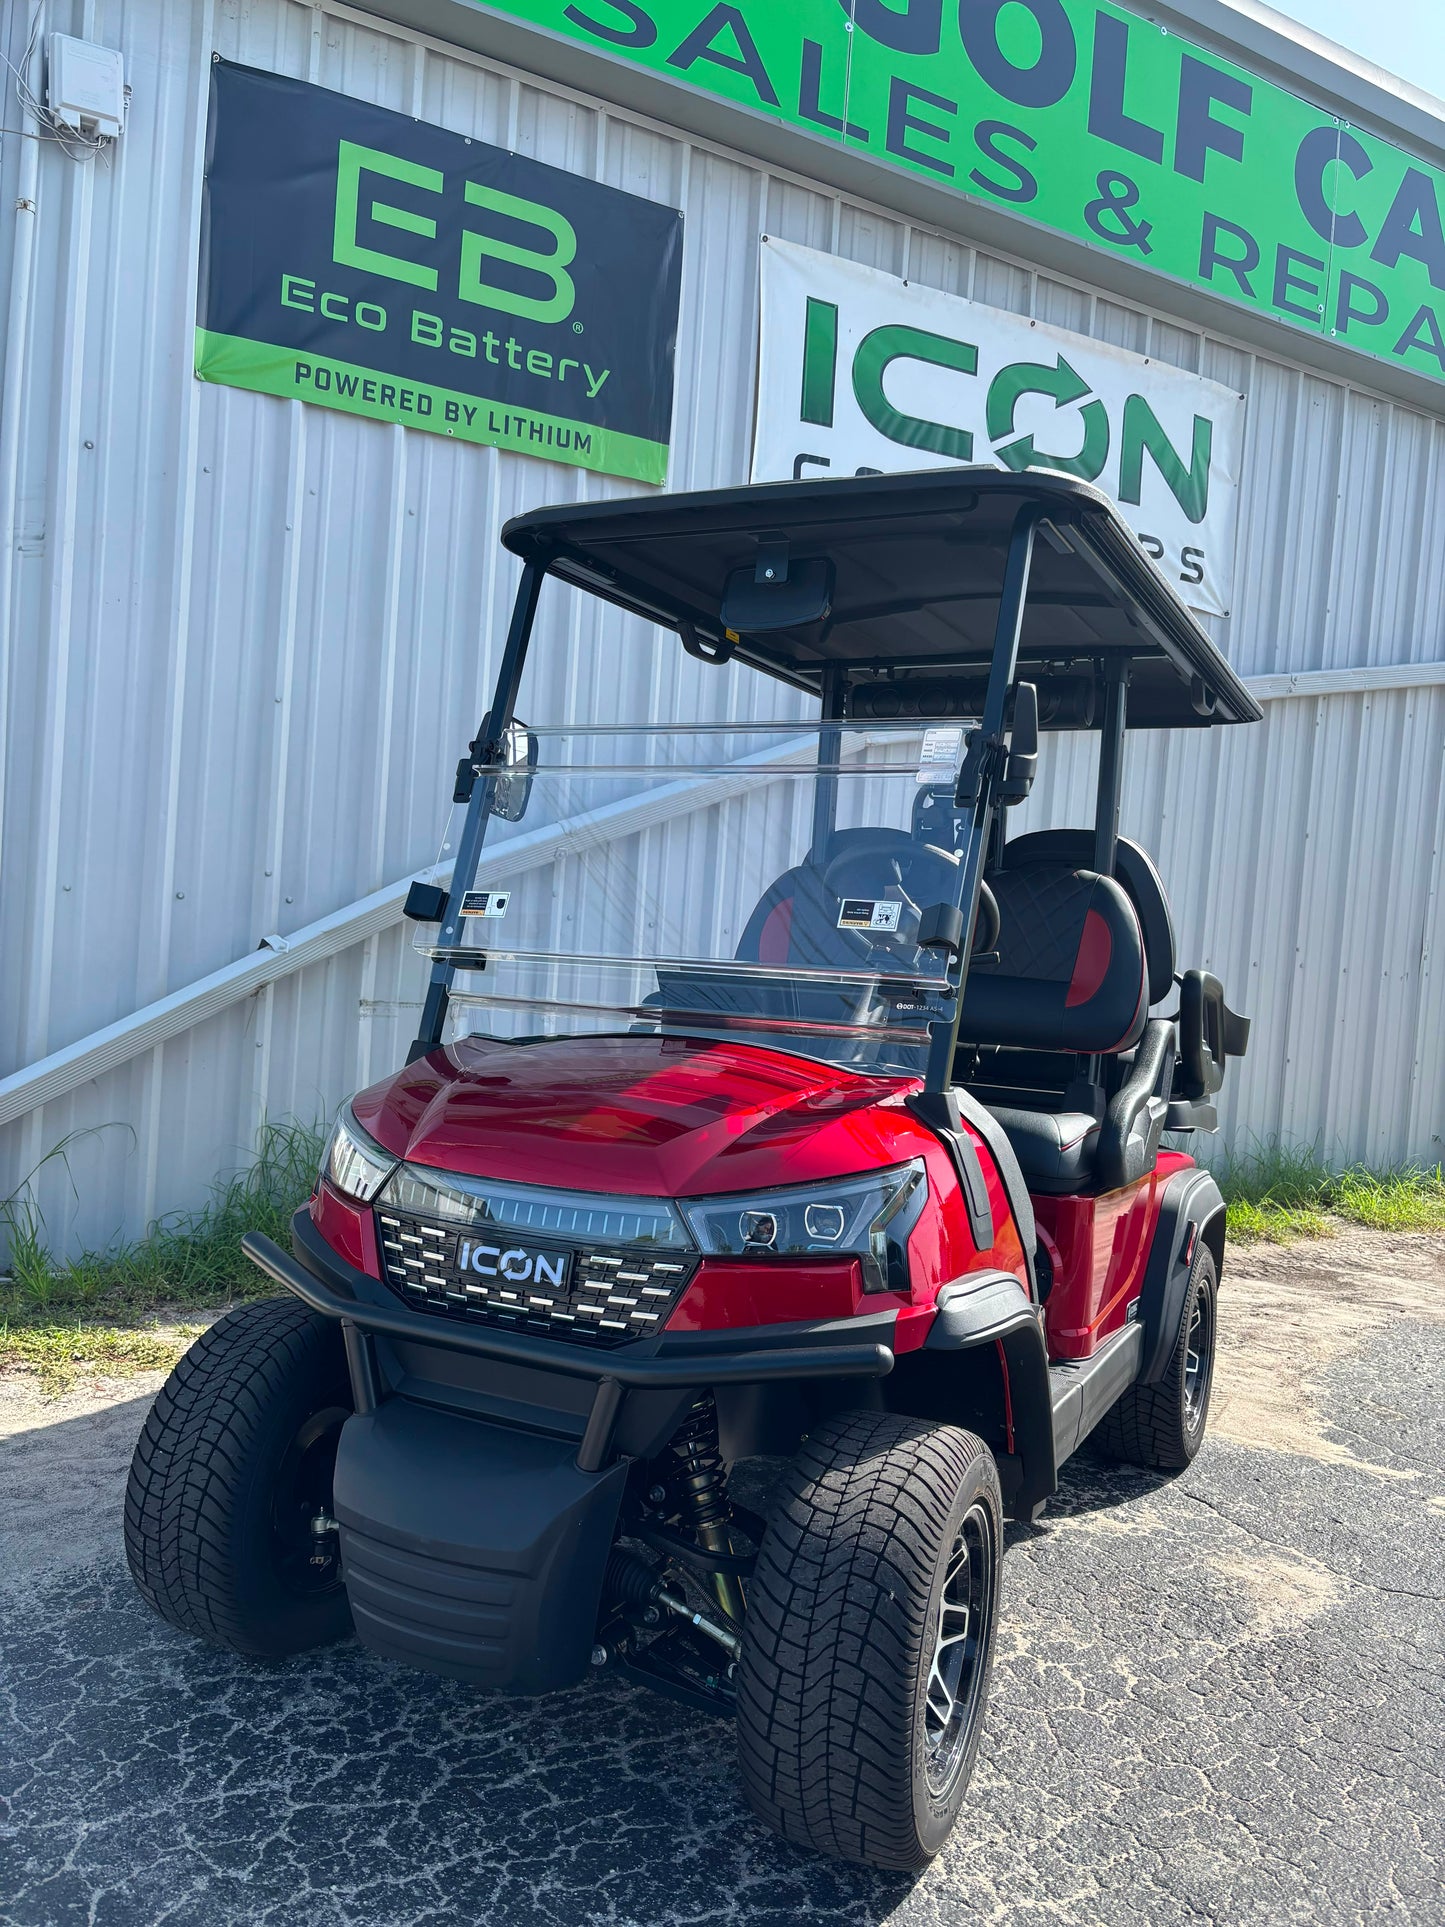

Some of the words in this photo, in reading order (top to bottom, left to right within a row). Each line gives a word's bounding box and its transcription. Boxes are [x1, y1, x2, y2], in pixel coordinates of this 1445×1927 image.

[332, 138, 578, 324] EB
[1083, 170, 1153, 256] &
[280, 273, 387, 332] Eco
[410, 309, 611, 398] Battery
[294, 361, 433, 417] POWERED
[444, 399, 478, 427] BY
[488, 411, 593, 454] LITHIUM
[800, 295, 1214, 524] ICON
[459, 1241, 566, 1288] ICON
